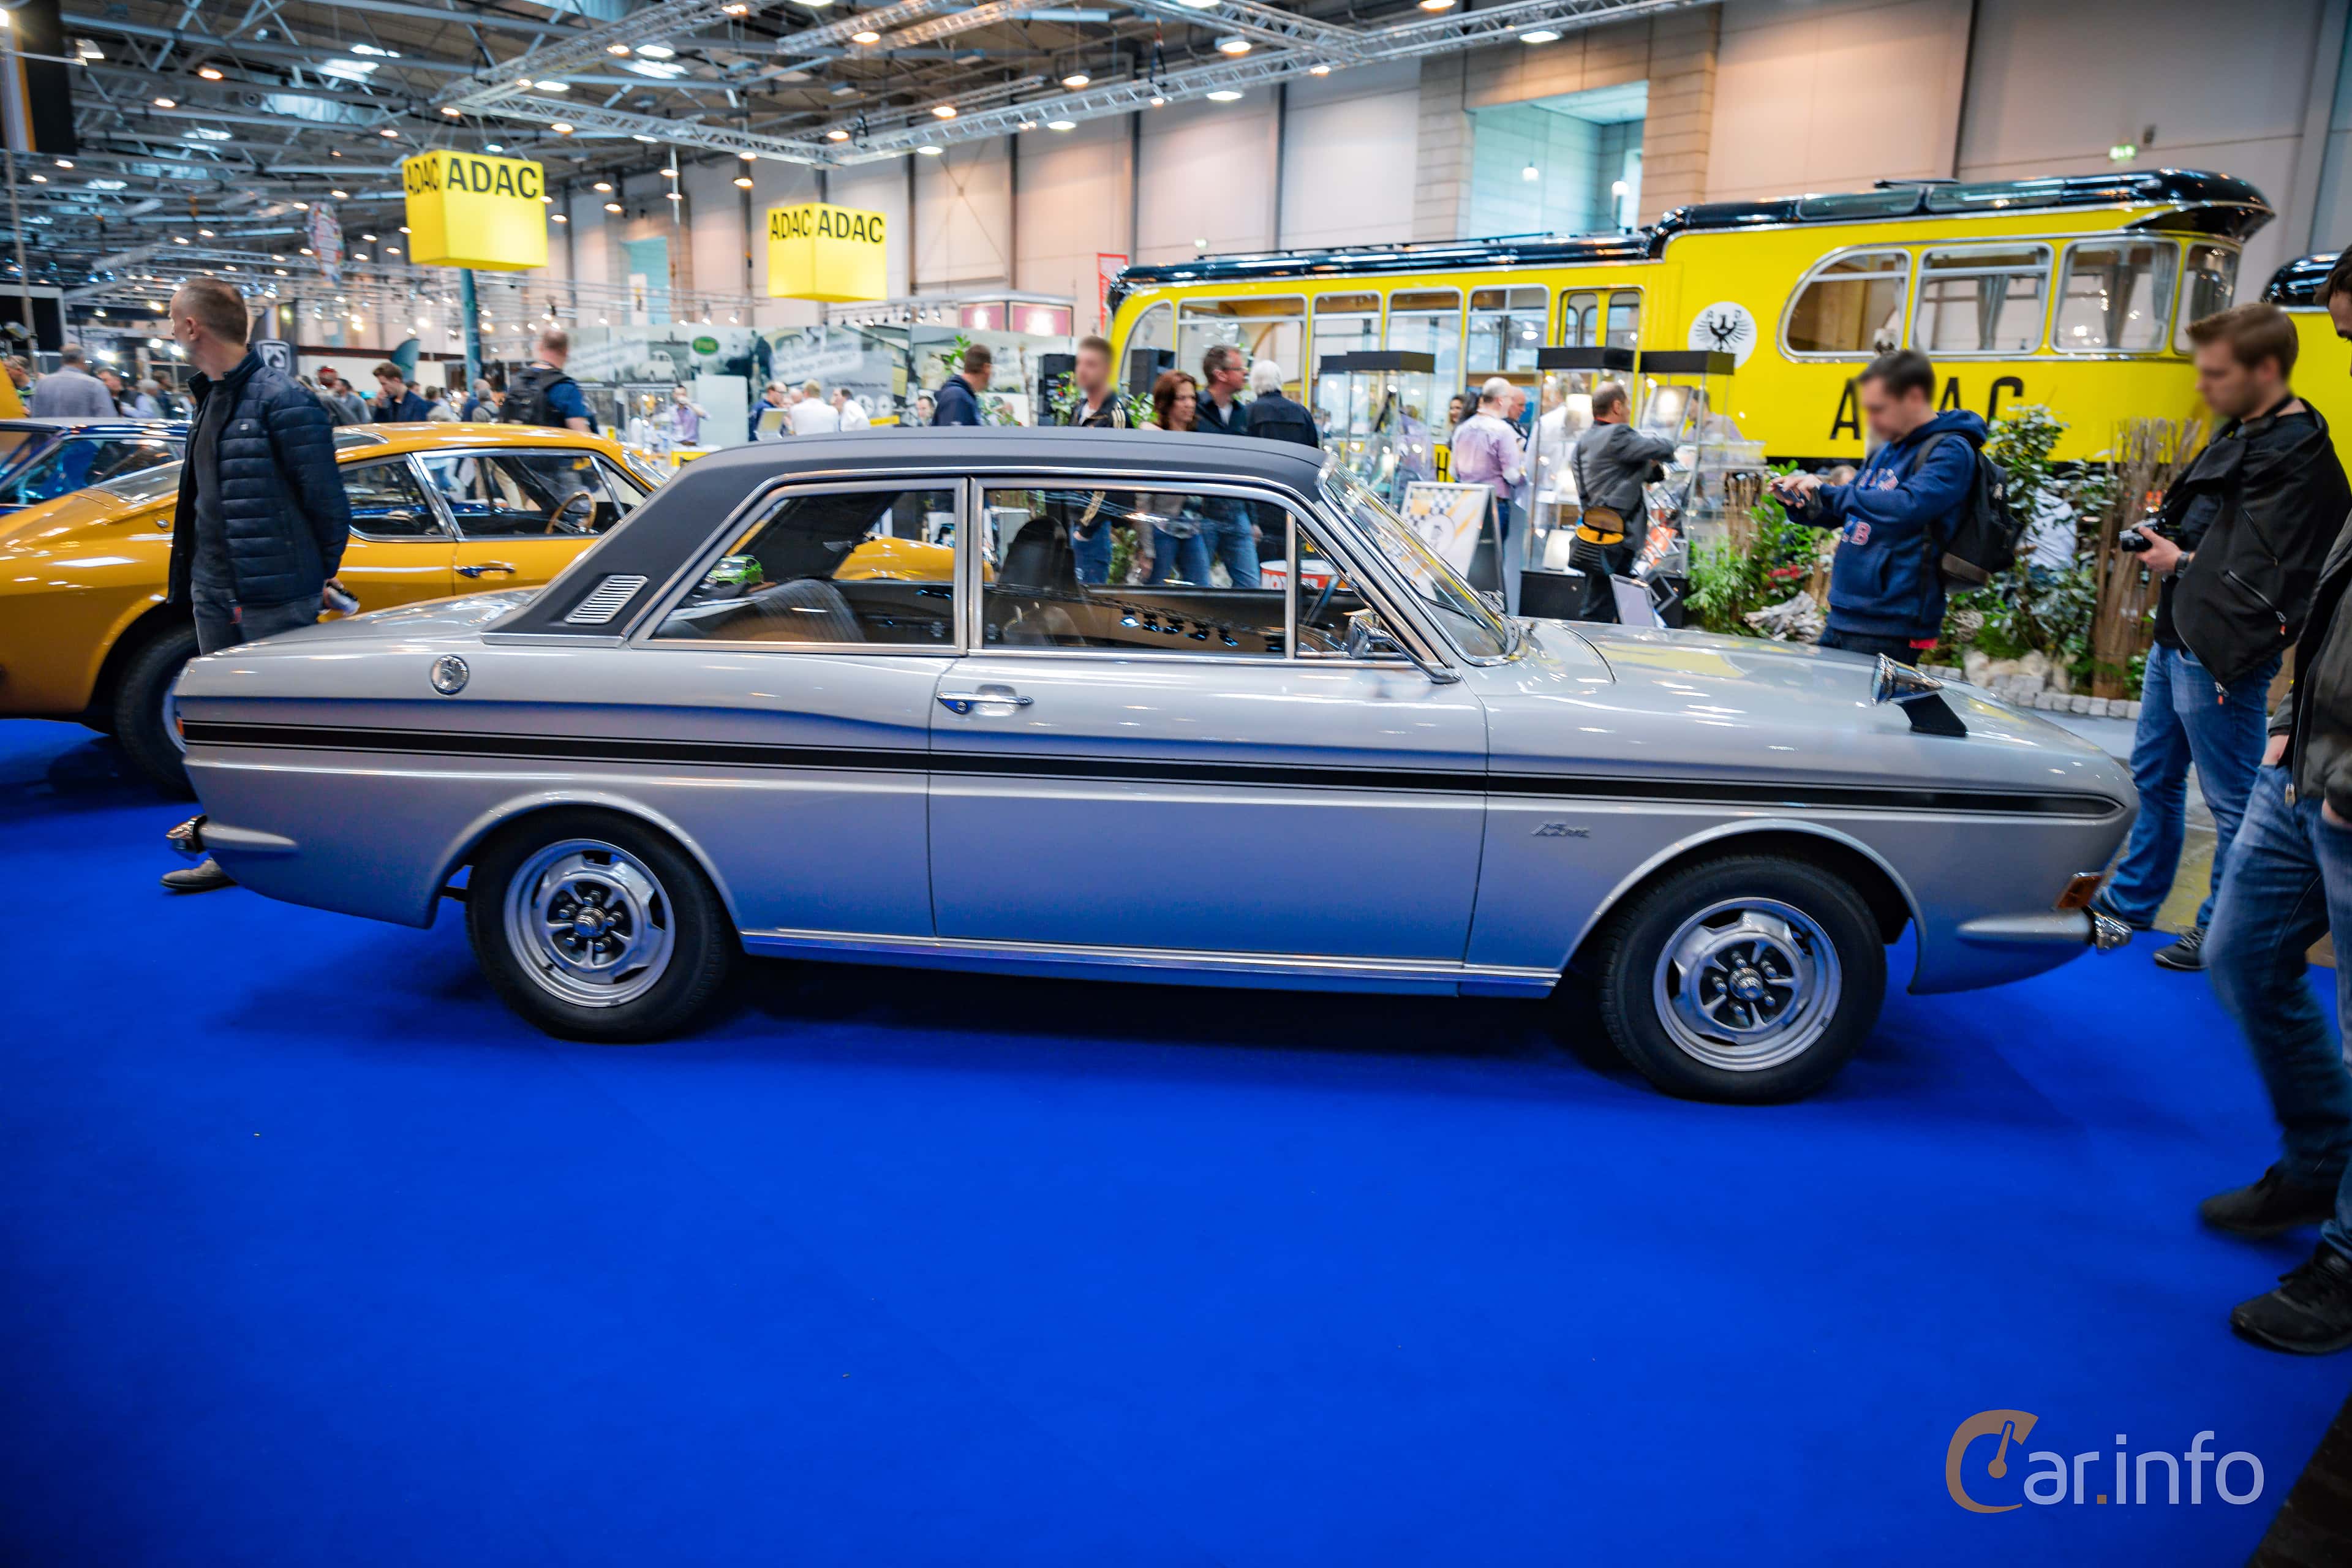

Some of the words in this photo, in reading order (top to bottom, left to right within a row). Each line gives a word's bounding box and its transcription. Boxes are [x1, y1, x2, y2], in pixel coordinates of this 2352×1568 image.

[407, 157, 439, 195] ADAC
[447, 158, 538, 198] ADAC
[771, 209, 811, 240] ADAC
[818, 209, 883, 243] ADAC
